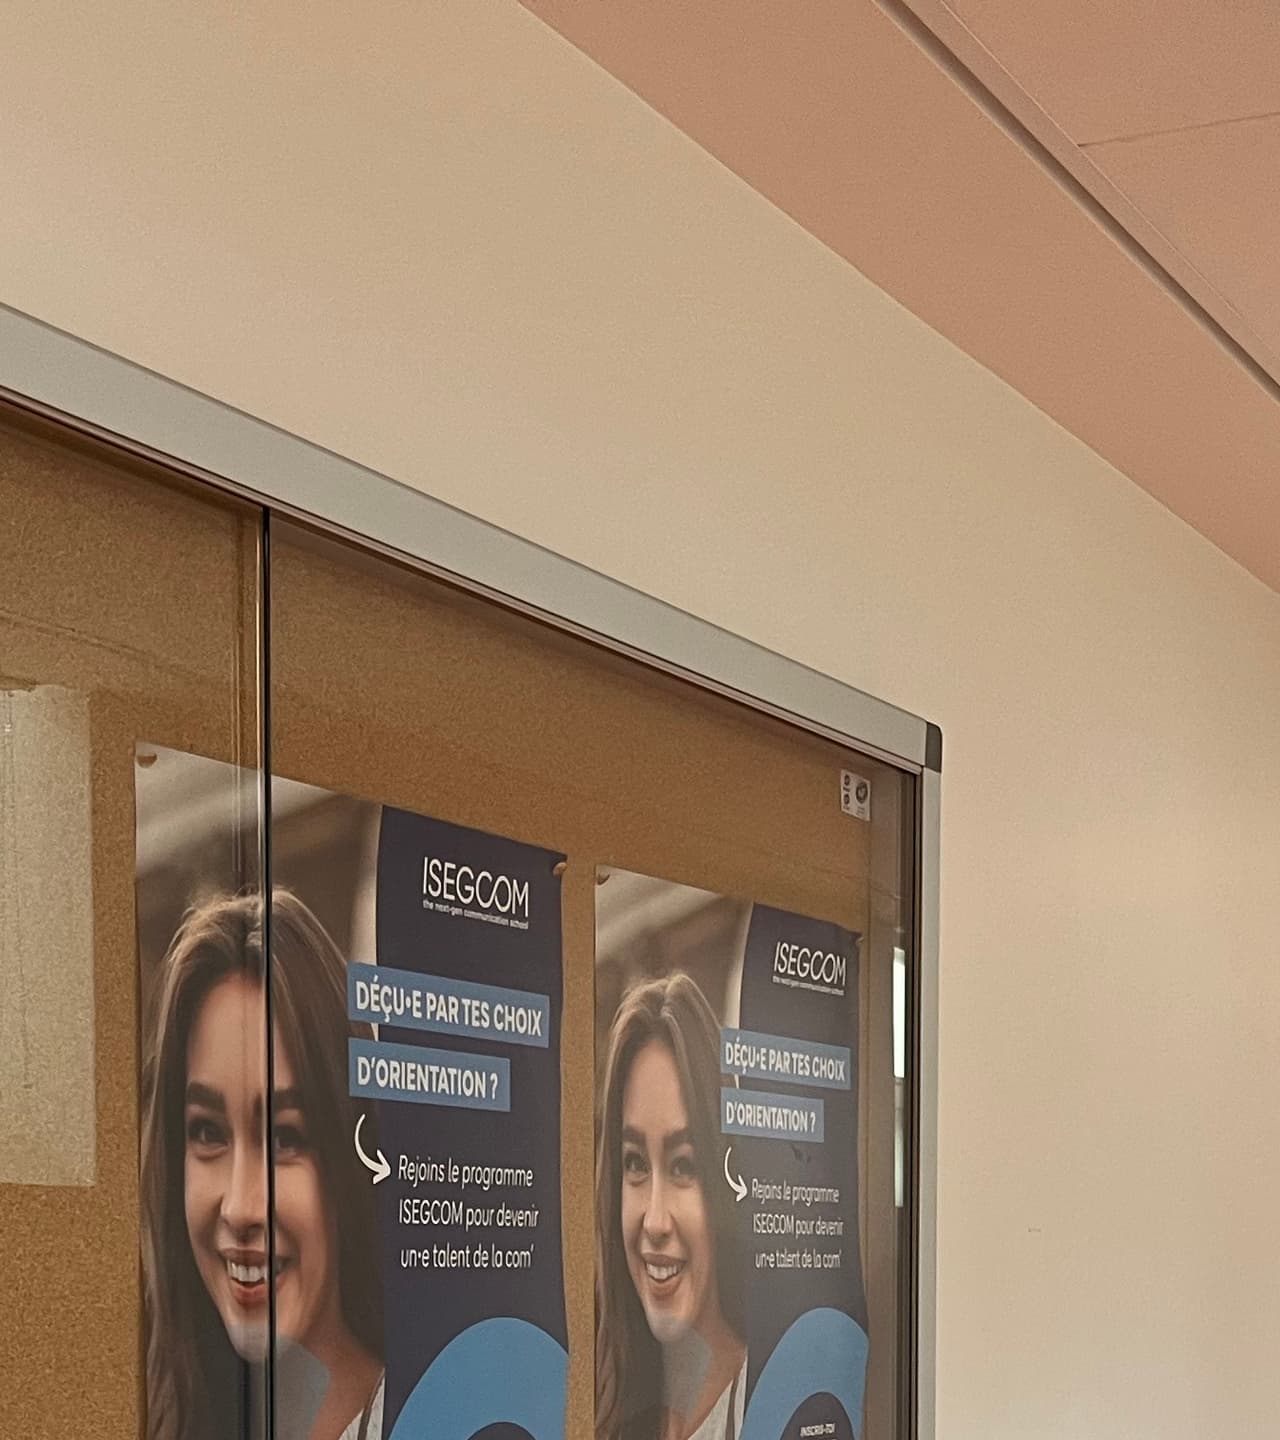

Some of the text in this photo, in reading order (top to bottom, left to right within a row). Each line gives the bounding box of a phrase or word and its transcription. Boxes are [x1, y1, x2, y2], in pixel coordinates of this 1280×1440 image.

[423, 856, 528, 917] ISEGCOM
[774, 941, 846, 986] ISEGCOM
[426, 992, 459, 1024] PAR
[462, 999, 489, 1028] TES
[493, 1004, 542, 1036] CHOIX
[358, 1056, 498, 1100] D'ORIENTATION ?
[769, 1049, 790, 1074] PAR
[792, 1052, 810, 1077] TES
[812, 1056, 845, 1081] CHOIX
[726, 1101, 816, 1133] D'ORIENTATION ?
[399, 1154, 533, 1190] Rejoins le programme
[752, 1178, 839, 1207] Rejoins le programme
[399, 1199, 539, 1232] ISEGCOM pour devenir
[754, 1213, 794, 1234] ISEGCOM
[796, 1220, 815, 1239] pour
[433, 1242, 470, 1268] talent
[473, 1243, 489, 1268] de
[492, 1243, 502, 1268] la
[506, 1243, 534, 1268] com'
[801, 1248, 812, 1268] de
[813, 1248, 821, 1268] la
